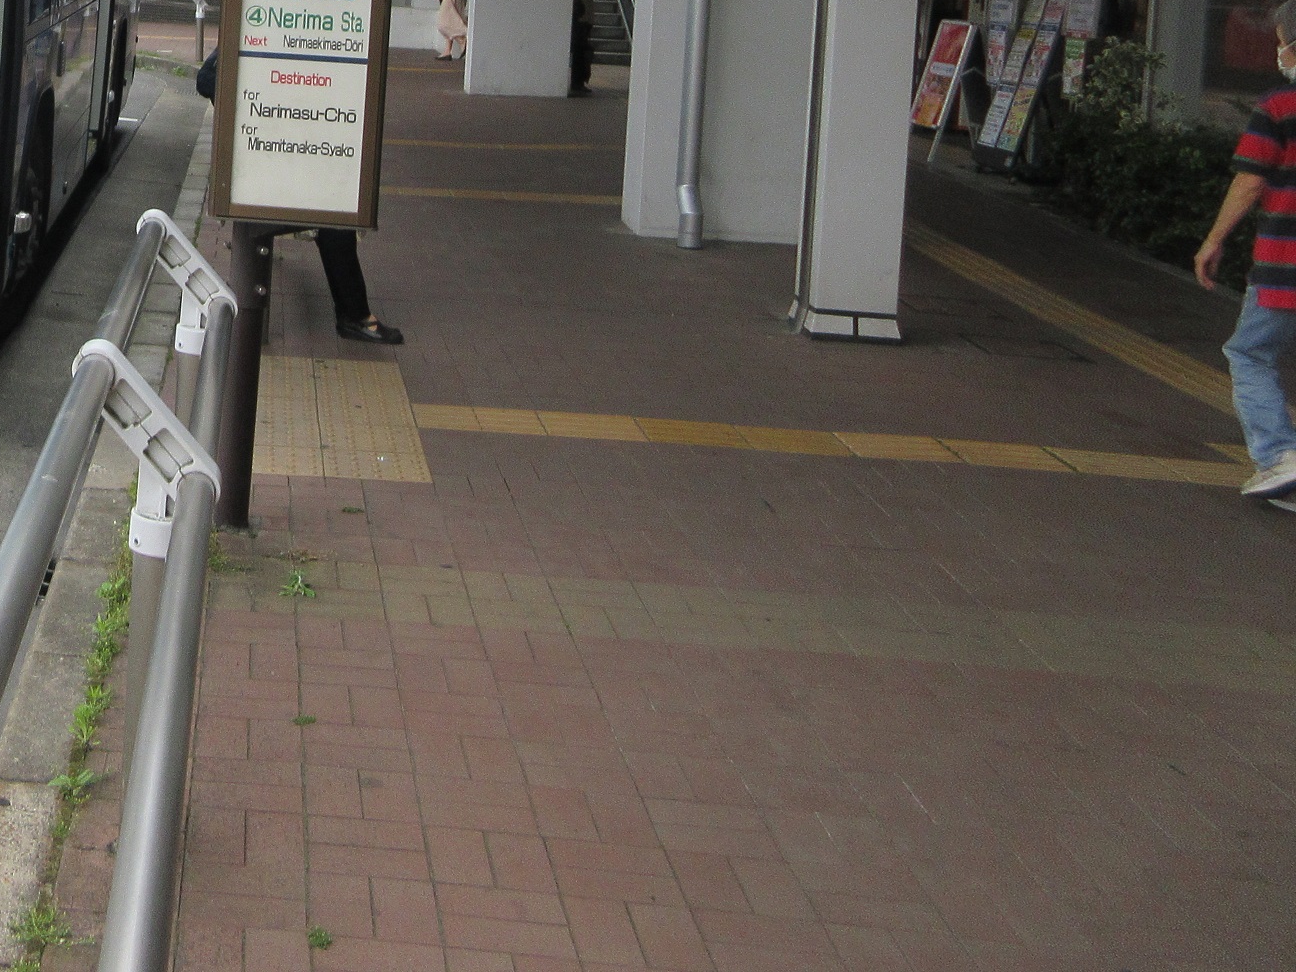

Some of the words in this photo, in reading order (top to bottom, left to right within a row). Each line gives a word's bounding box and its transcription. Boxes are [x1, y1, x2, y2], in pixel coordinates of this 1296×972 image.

[268, 7, 333, 31] Nerima
[341, 11, 364, 33] Sta.
[245, 35, 267, 47] Next
[270, 70, 332, 87] Destination
[243, 89, 260, 101] for
[241, 124, 258, 135] for
[247, 137, 355, 158] Minamitanaka-Syako
